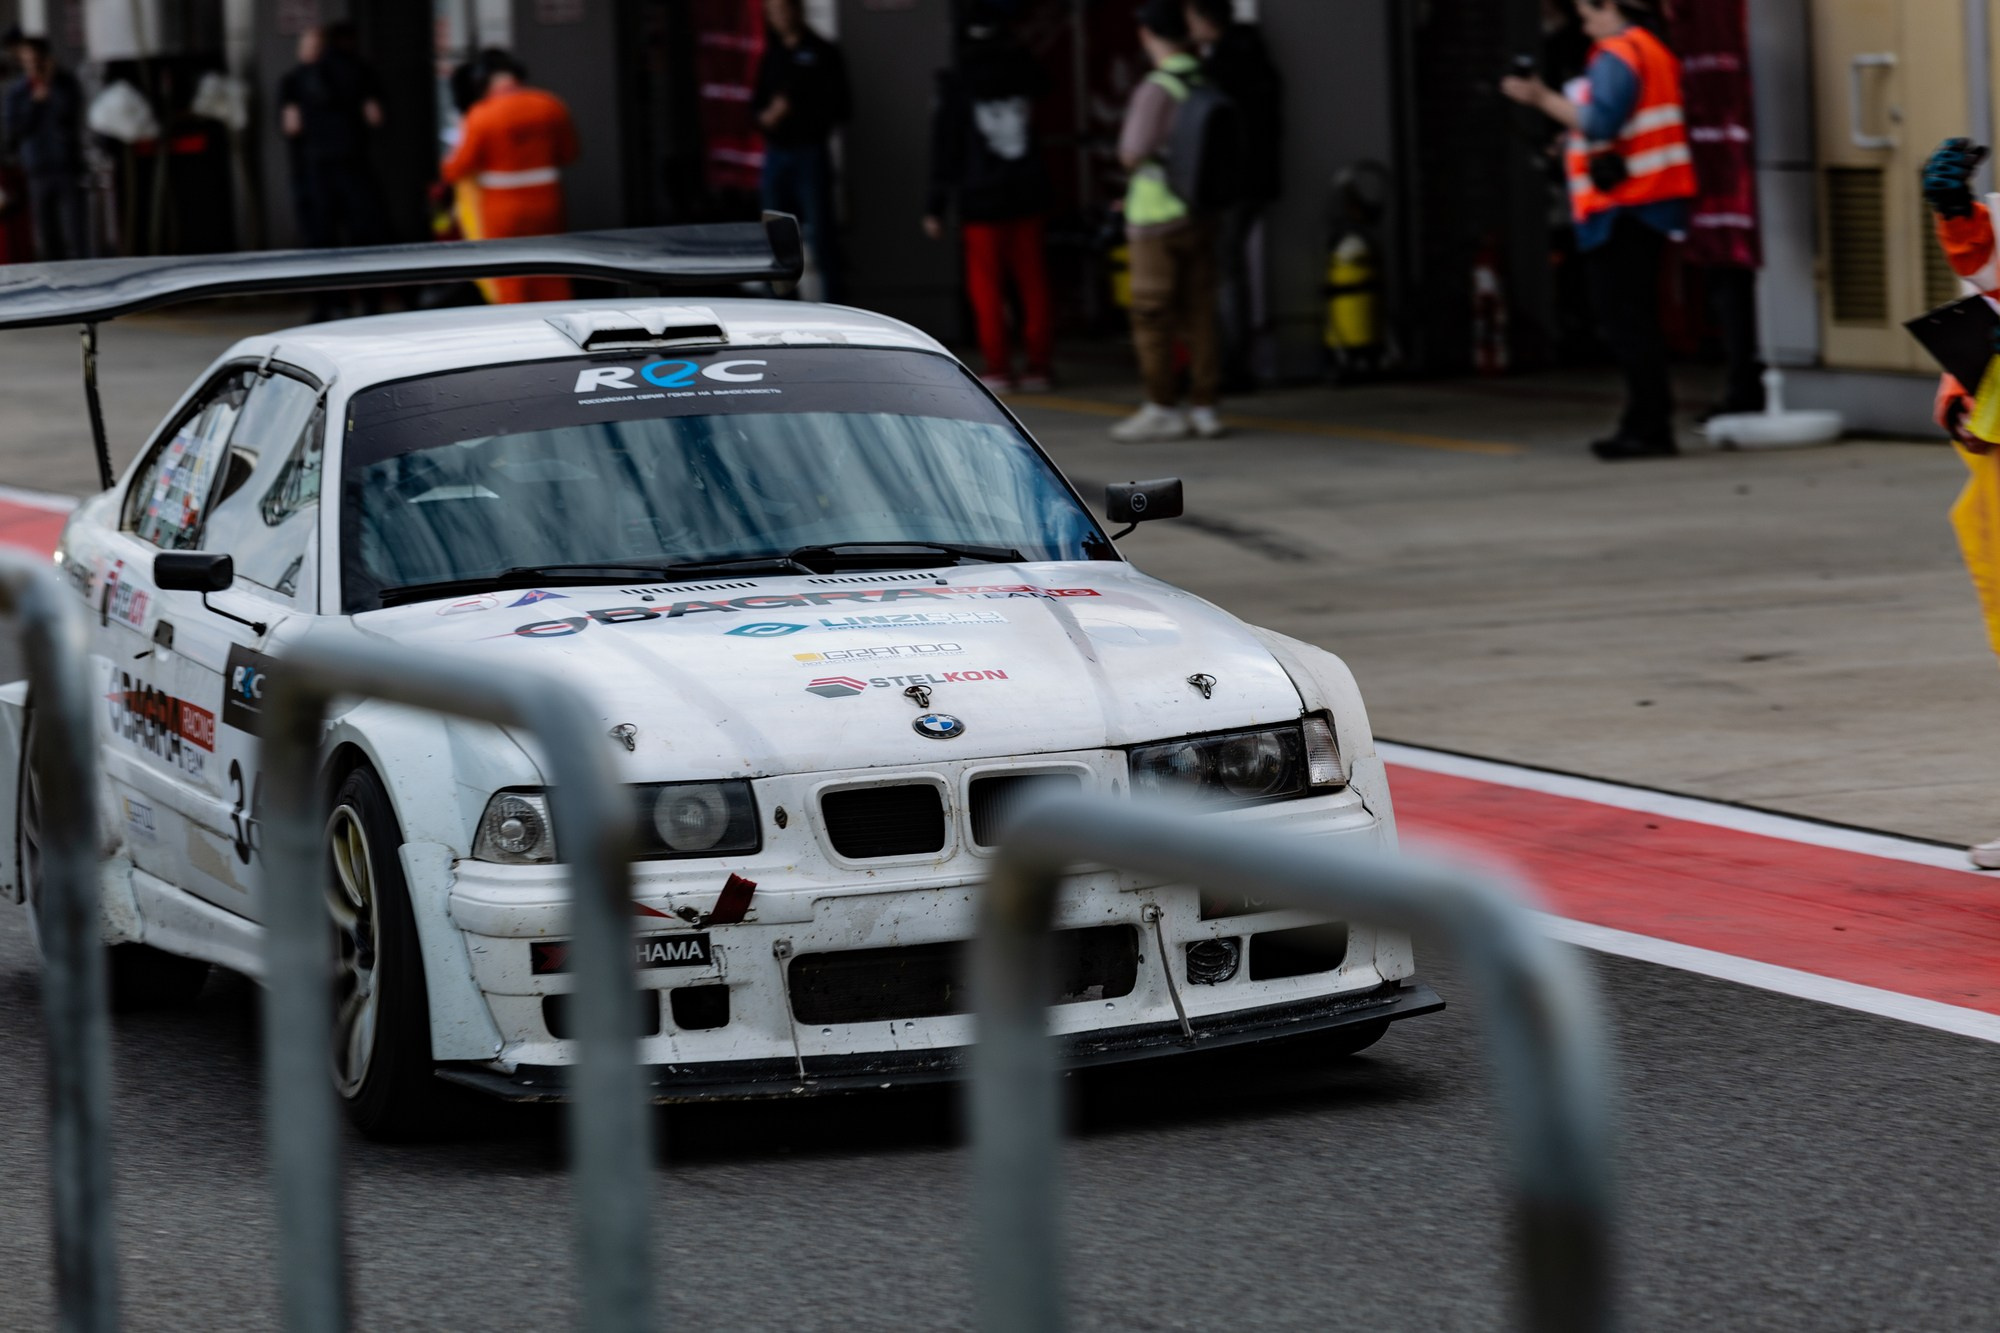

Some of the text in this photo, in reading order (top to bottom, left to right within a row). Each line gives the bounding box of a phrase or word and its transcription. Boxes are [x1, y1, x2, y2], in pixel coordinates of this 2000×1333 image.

[965, 592, 1057, 602] TEAM
[822, 642, 962, 660] GRANDO
[869, 669, 1009, 688] STELKON
[635, 940, 704, 963] HAMA
